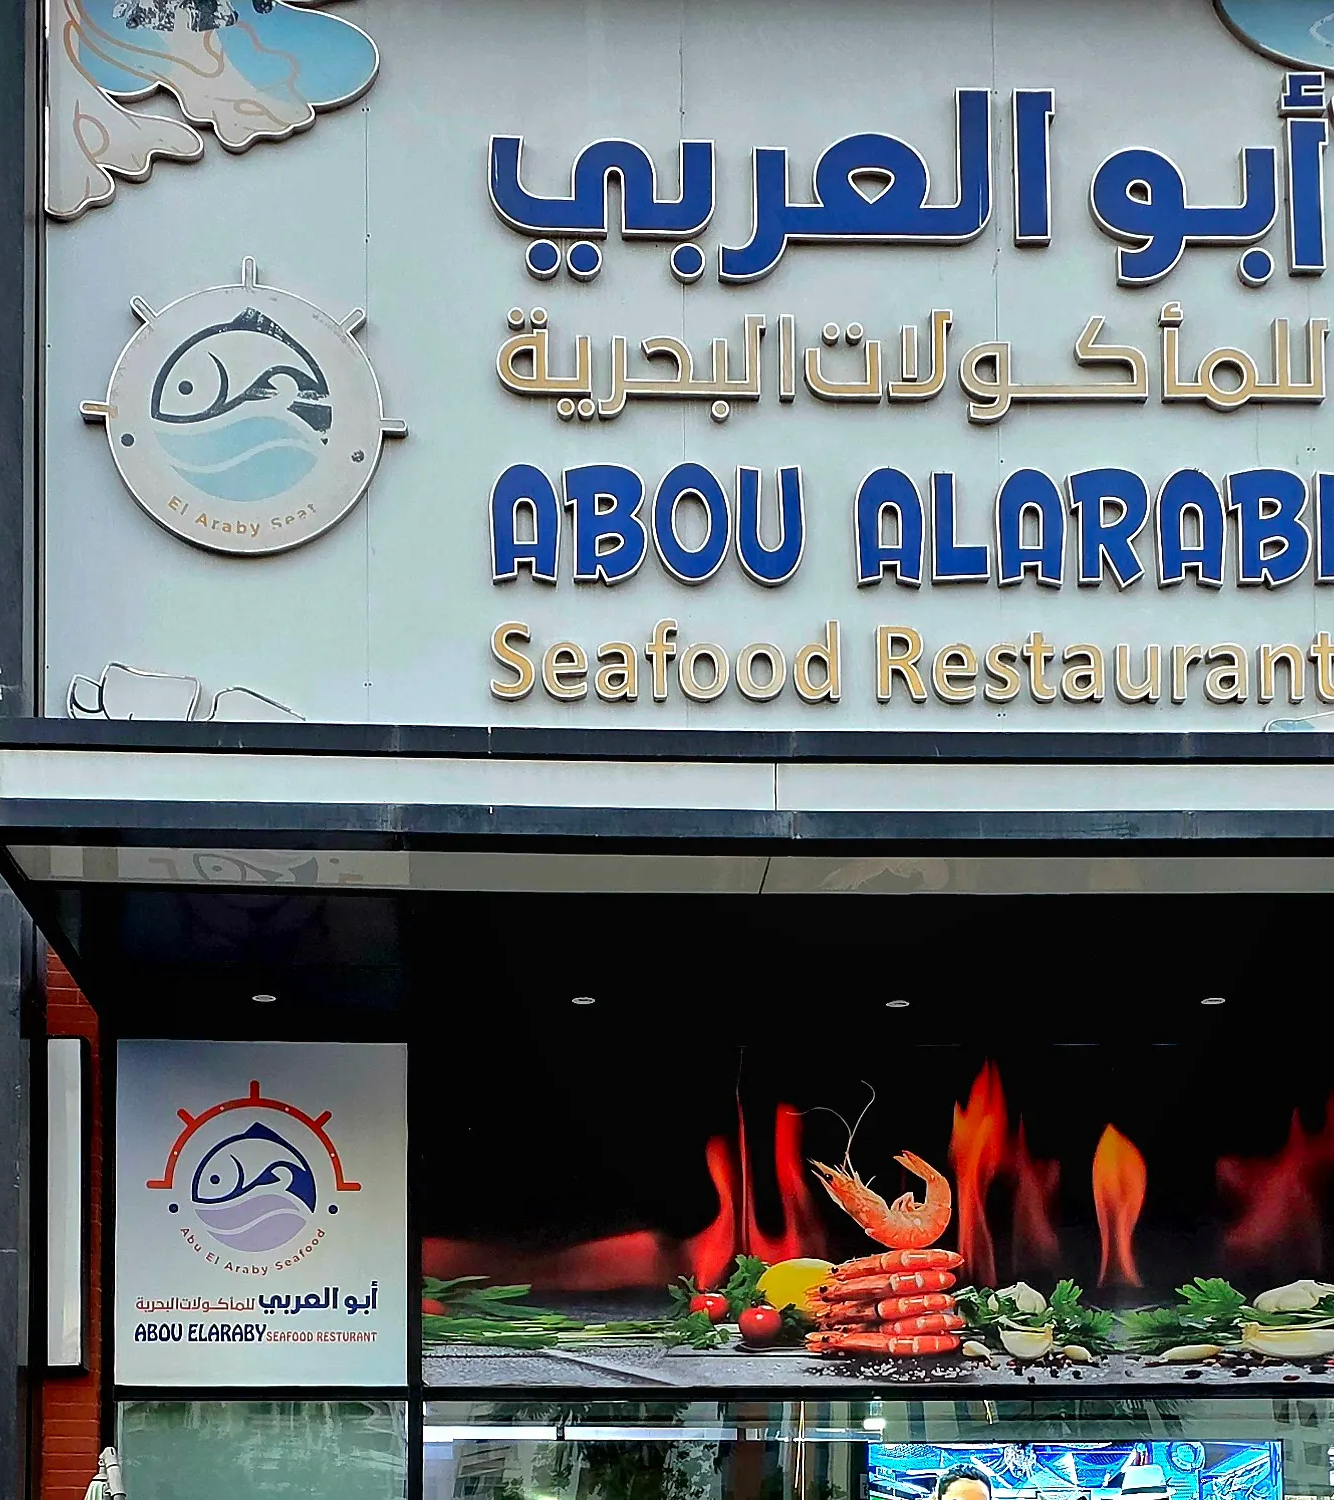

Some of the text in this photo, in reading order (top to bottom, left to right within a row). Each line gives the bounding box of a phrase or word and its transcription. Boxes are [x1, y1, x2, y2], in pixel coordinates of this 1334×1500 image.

[487, 73, 1329, 288] أبو العربي
[495, 306, 795, 424] البحرية
[195, 512, 260, 538] Araby
[490, 461, 805, 587] ABOU
[489, 618, 843, 705] Seafood
[180, 1227, 326, 1276] Abu El Araby Seafood
[258, 1287, 340, 1315] العربي
[344, 1280, 379, 1315] أبو
[135, 1323, 378, 1342] ABOU ELARABY SEAFOOD RESTURANT
